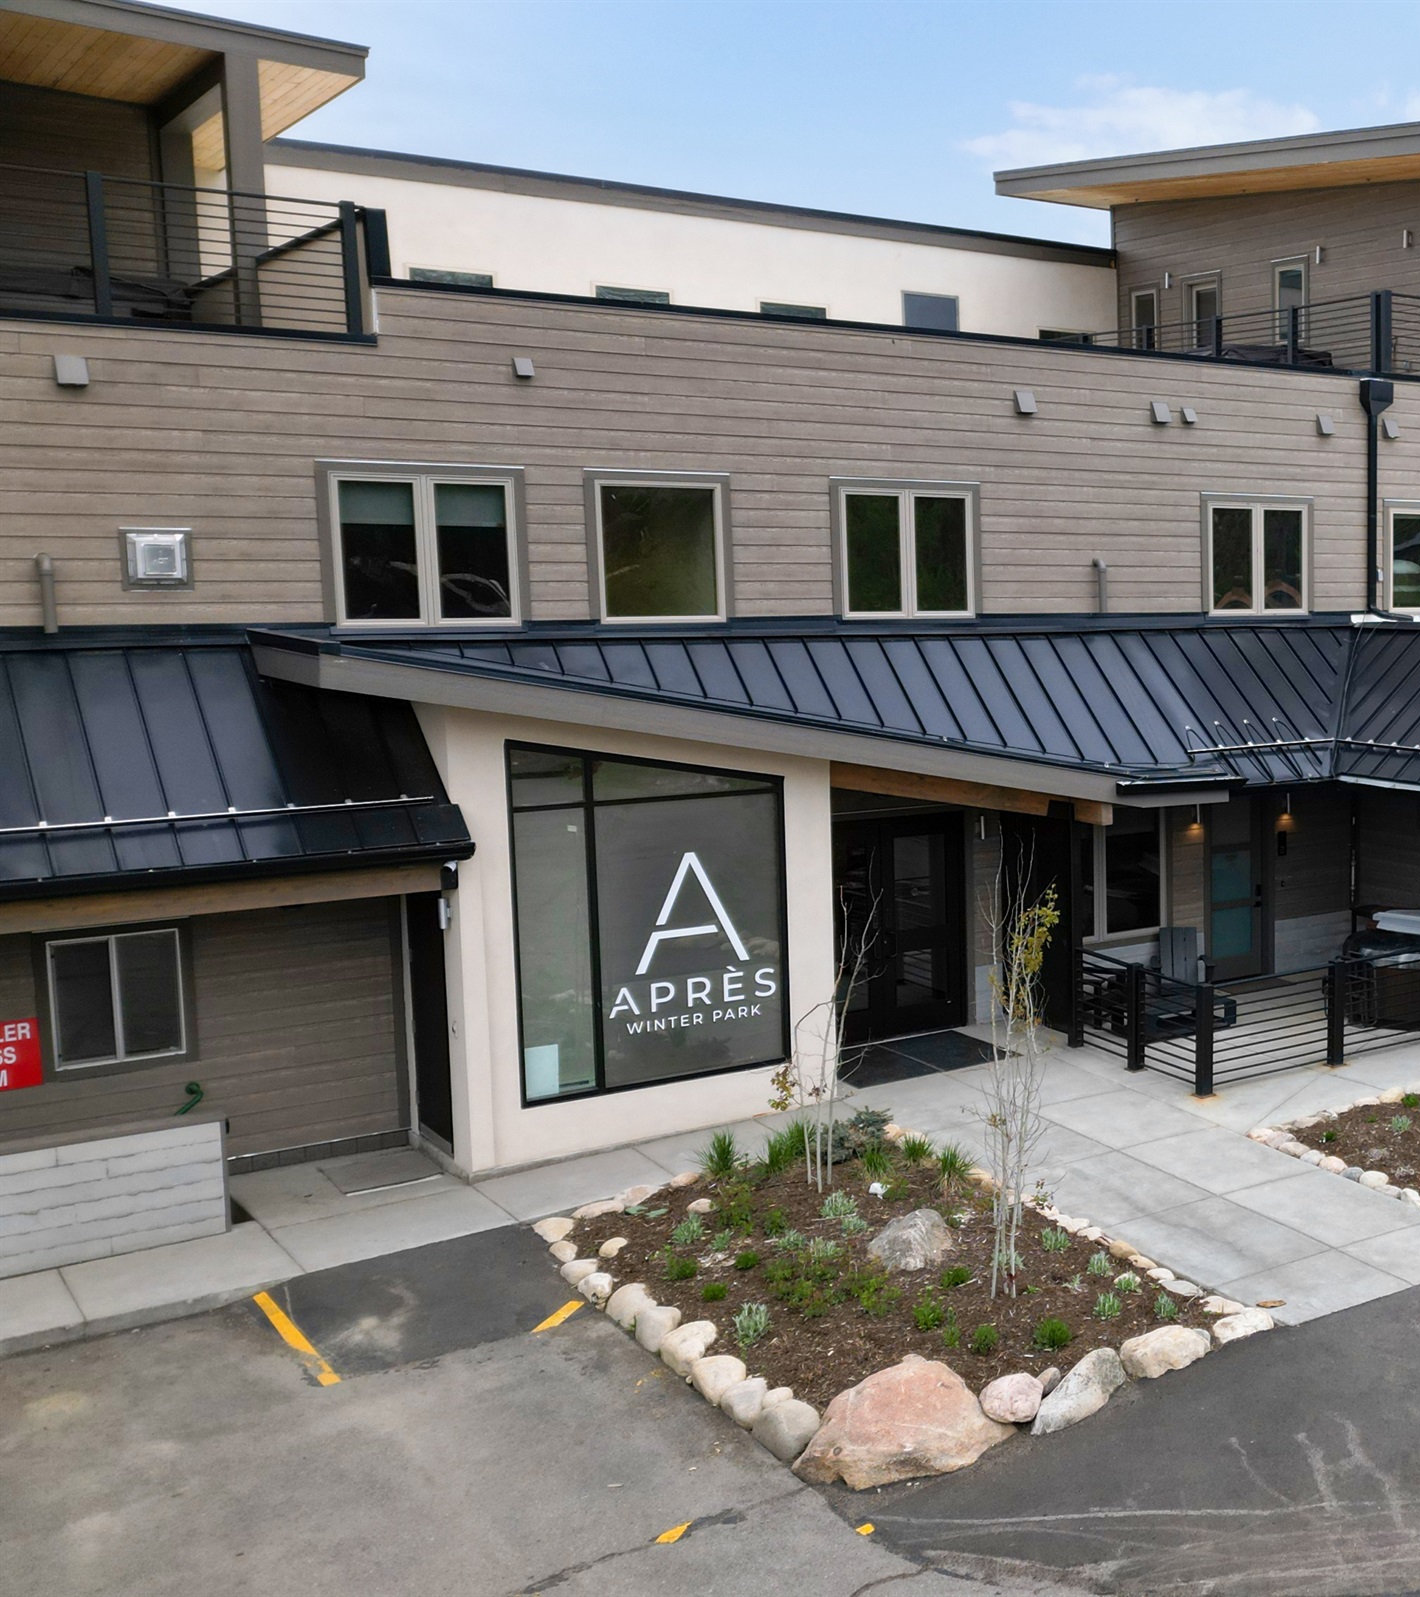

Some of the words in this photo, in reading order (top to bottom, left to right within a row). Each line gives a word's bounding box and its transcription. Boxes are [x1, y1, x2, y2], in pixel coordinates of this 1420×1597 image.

[635, 852, 750, 975] A
[609, 966, 777, 1019] APRÈS
[626, 1013, 704, 1035] WINTER
[712, 1003, 762, 1022] PARK
[0, 1046, 17, 1065] S
